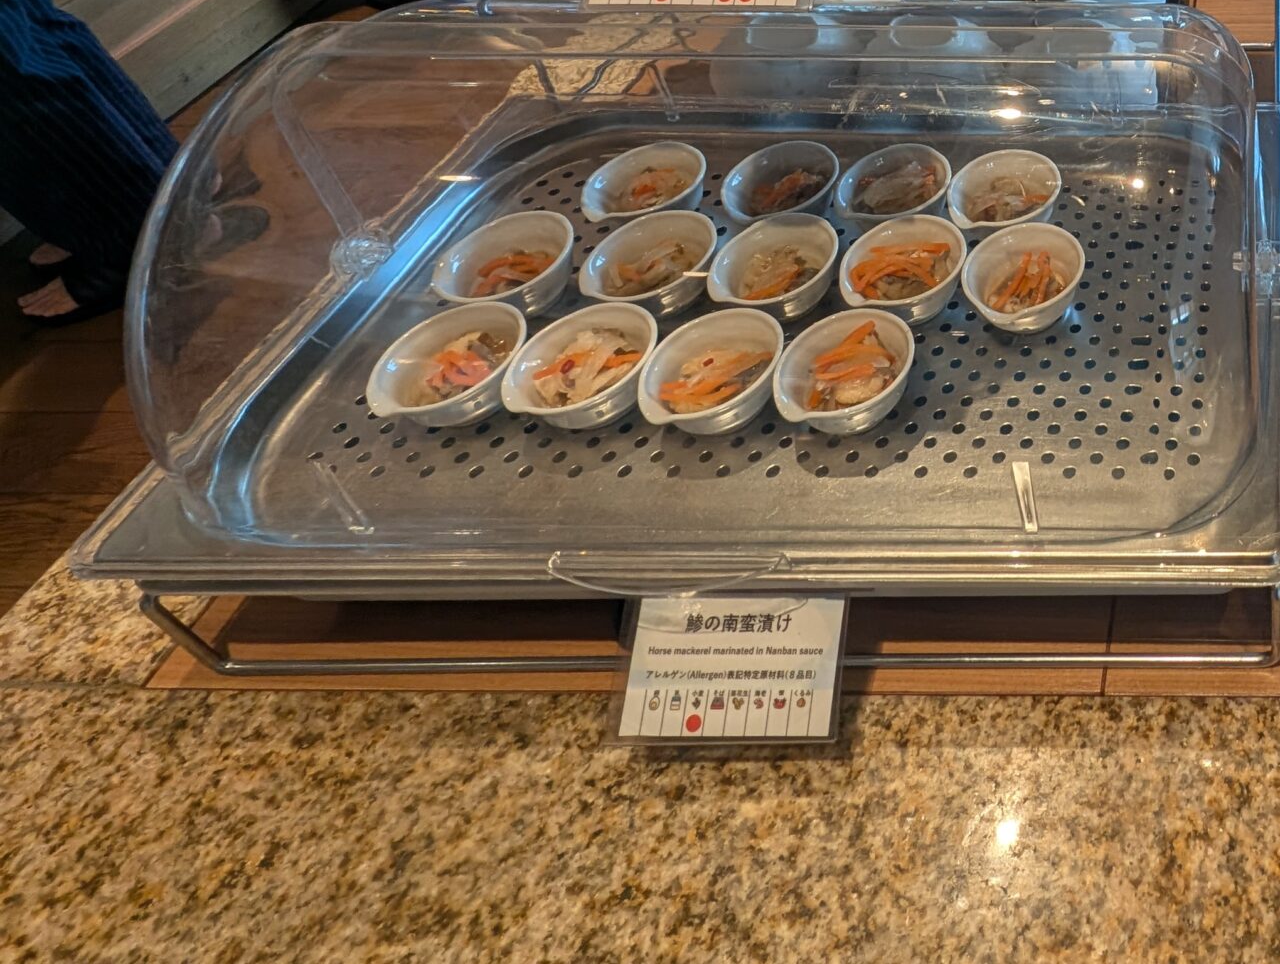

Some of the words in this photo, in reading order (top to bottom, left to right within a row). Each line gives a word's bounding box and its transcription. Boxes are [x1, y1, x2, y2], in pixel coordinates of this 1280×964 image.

[648, 646, 672, 655] Horse
[674, 646, 711, 655] mackerel
[713, 646, 753, 655] marinated
[756, 647, 763, 655] in
[766, 647, 797, 655] Nanban
